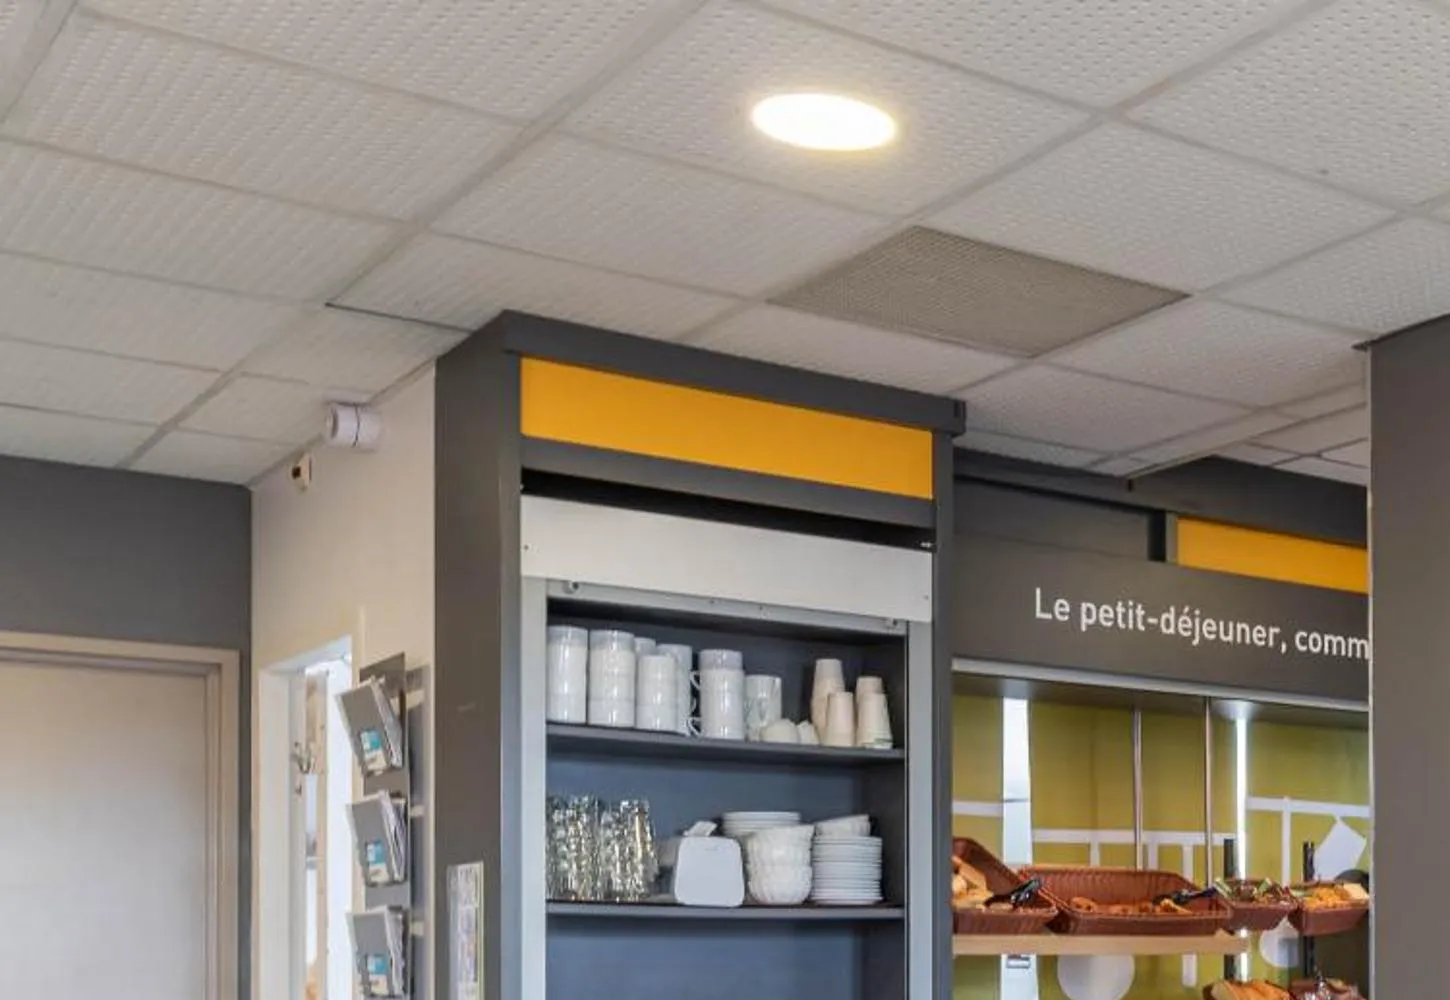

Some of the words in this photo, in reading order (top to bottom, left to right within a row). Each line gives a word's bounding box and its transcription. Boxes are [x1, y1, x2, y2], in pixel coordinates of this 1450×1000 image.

[1035, 587, 1070, 621] Le
[1080, 600, 1287, 654] petit-déjeuner,
[1295, 629, 1370, 661] comm
